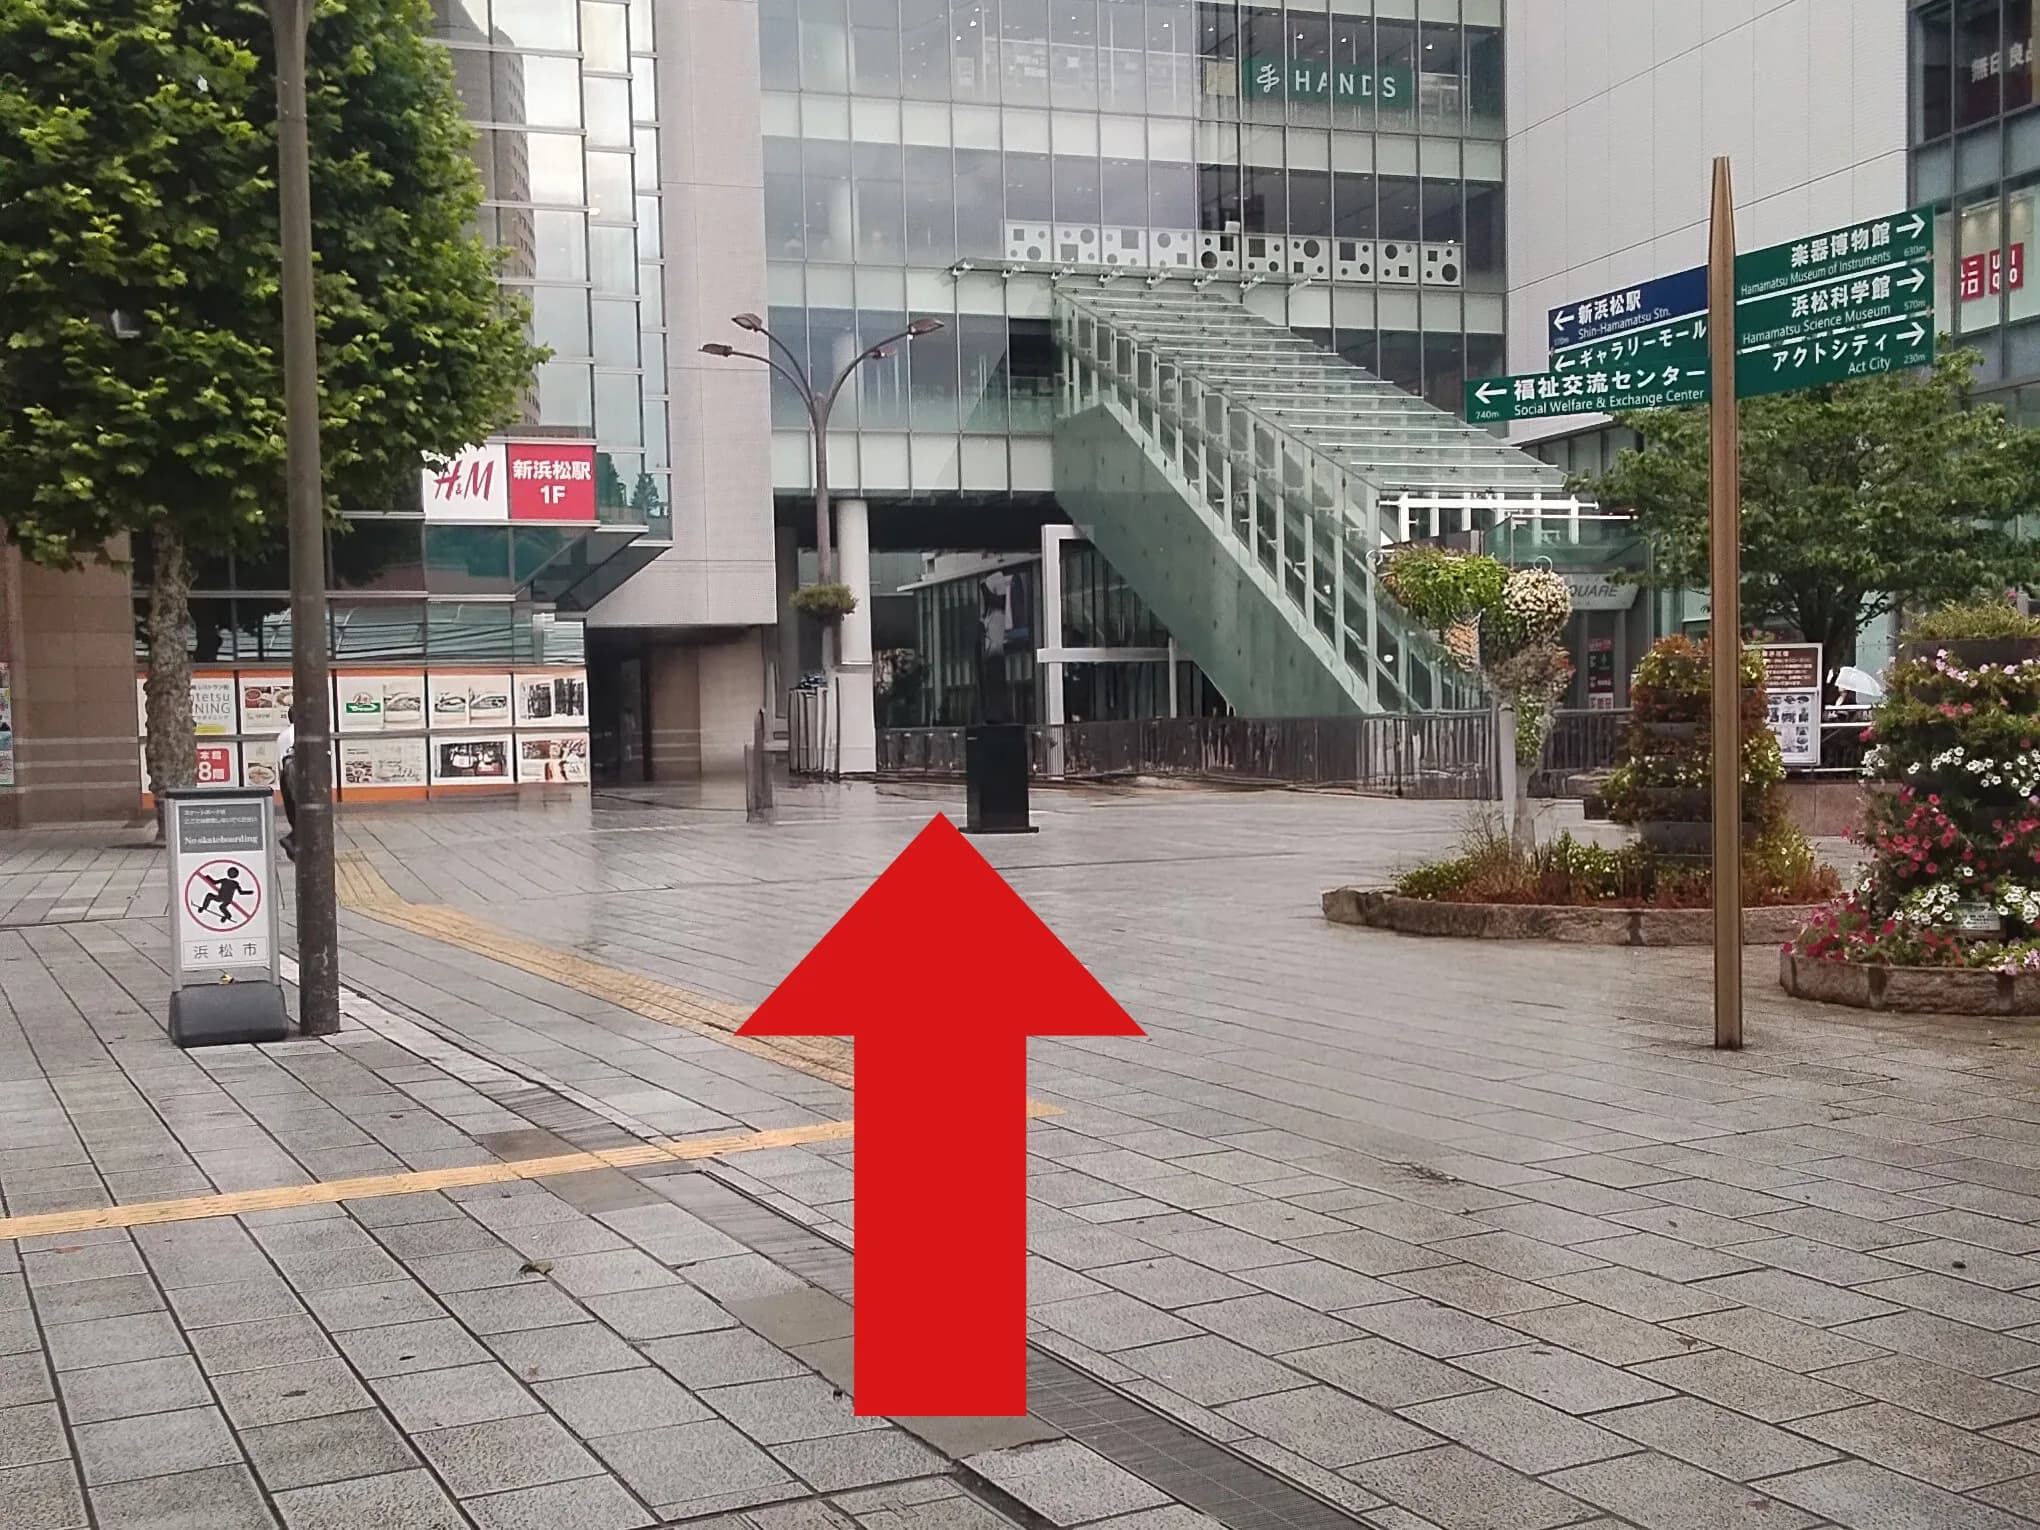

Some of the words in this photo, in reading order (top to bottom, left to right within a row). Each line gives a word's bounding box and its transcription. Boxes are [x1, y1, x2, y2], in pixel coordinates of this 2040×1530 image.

[1295, 69, 1397, 98] HANDS
[1790, 222, 1891, 268] 楽器博物館
[1903, 245, 1927, 256] 630m
[1740, 275, 1789, 297] Hamamatsu
[1790, 267, 1827, 285] Museum
[1828, 264, 1838, 276] of
[1839, 250, 1891, 274] Instruments
[1577, 289, 1641, 325] 新浜松駅
[1791, 275, 1891, 318] 浜松科学館
[1903, 299, 1926, 311] 570m
[1578, 312, 1652, 340] Shin-Hamamatsu
[1653, 308, 1672, 320] Stn.
[1742, 323, 1801, 345] Hamamatsu
[1803, 314, 1842, 332] Science
[1845, 303, 1891, 323] Museum
[1579, 319, 1707, 369] ギャラリーモール
[1772, 333, 1888, 372] アクトシティ
[1903, 352, 1926, 364] 230m
[1848, 360, 1866, 375] Act
[1869, 356, 1891, 372] City
[1513, 365, 1706, 402] 福祉交流センター
[1475, 410, 1500, 420] 740m
[1514, 403, 1547, 416] Social
[1549, 397, 1593, 413] Welfare
[1595, 397, 1607, 409] &
[1609, 391, 1664, 408] Exchange
[1666, 388, 1705, 403] Center
[434, 460, 495, 501] H&M
[512, 459, 592, 481] 新浜松駅
[539, 485, 567, 505] 1F
[1568, 584, 1619, 598] QUARE
[184, 836, 197, 845] No
